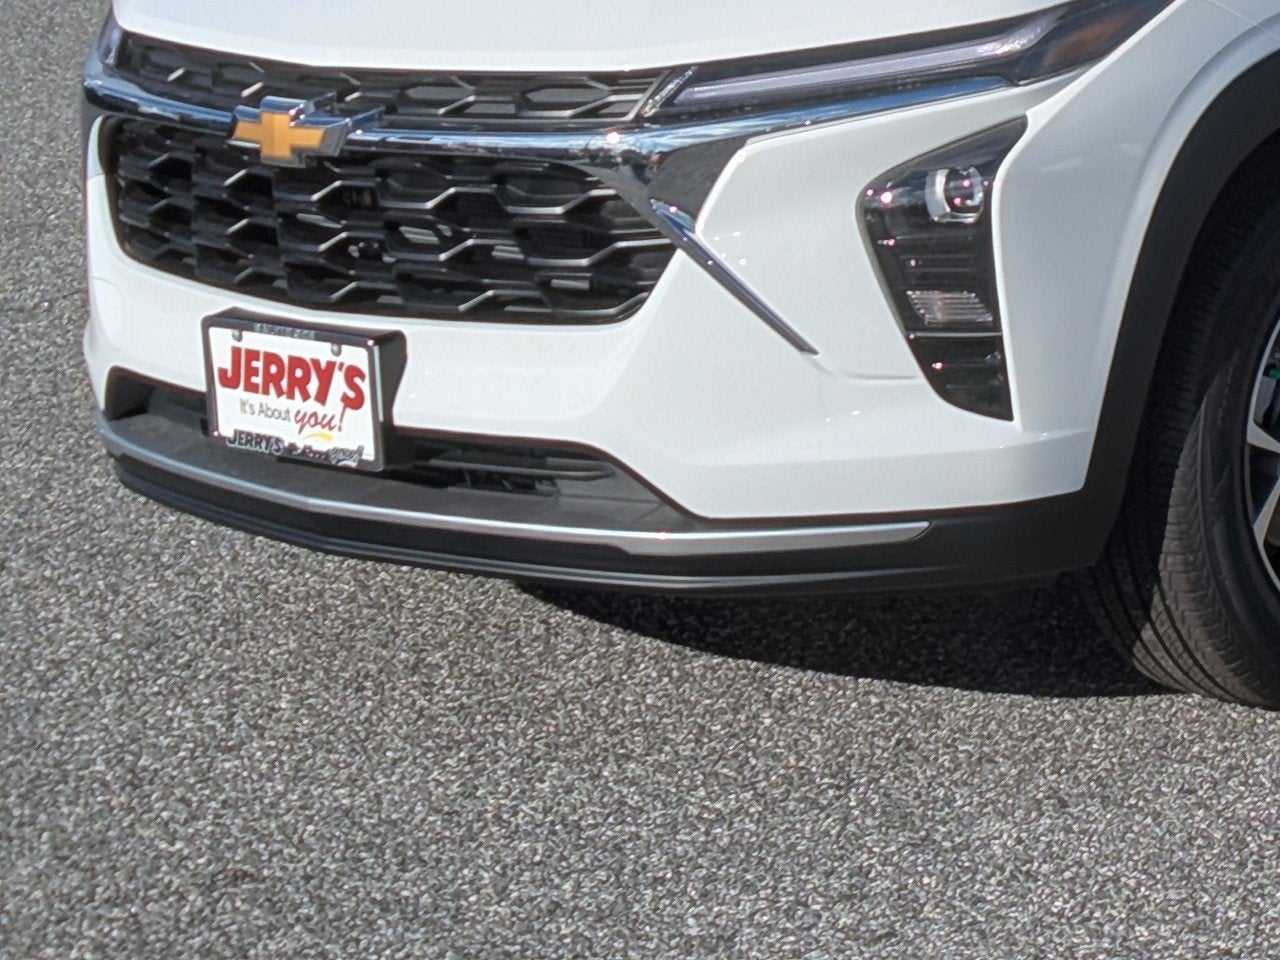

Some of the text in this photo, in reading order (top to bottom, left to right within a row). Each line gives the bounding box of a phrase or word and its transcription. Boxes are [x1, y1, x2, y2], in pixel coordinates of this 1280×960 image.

[218, 345, 366, 411] JERRY'S
[240, 398, 346, 436] It's About you!
